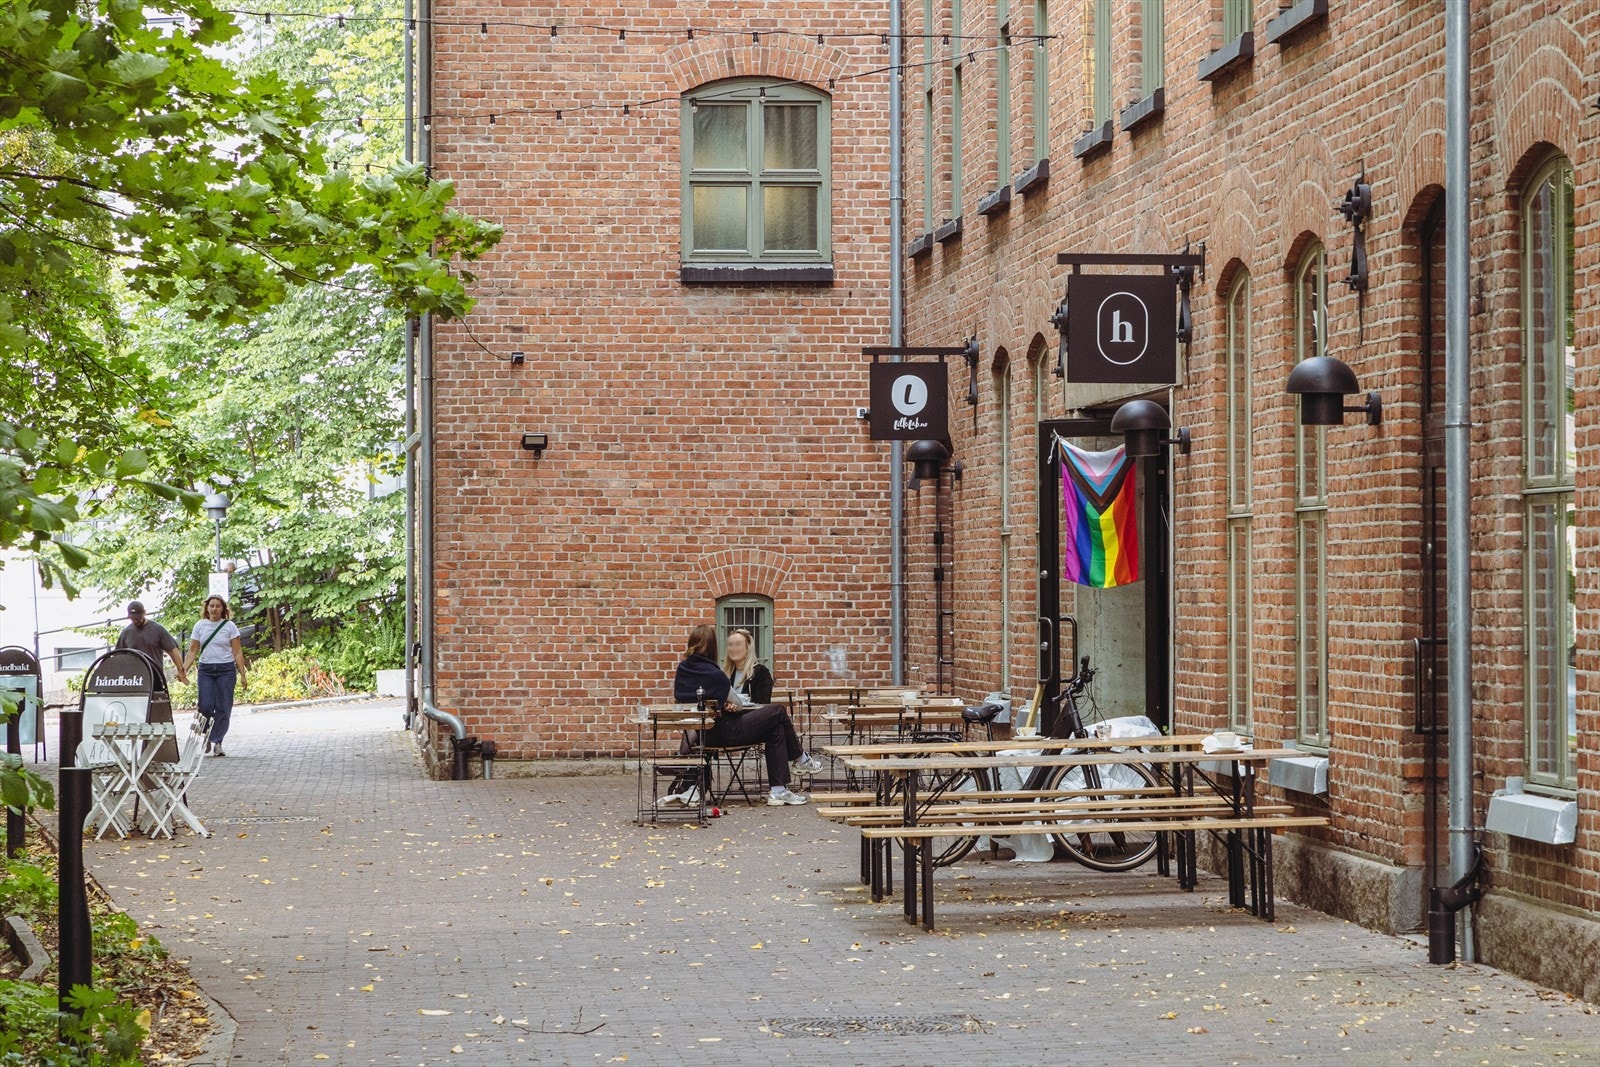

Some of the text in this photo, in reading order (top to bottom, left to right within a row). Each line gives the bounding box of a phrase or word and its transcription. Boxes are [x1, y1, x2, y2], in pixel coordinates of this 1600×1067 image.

[1110, 309, 1136, 343] h
[904, 383, 918, 405] L
[95, 675, 143, 687] håndbakt
[89, 742, 131, 760] ÅPET
